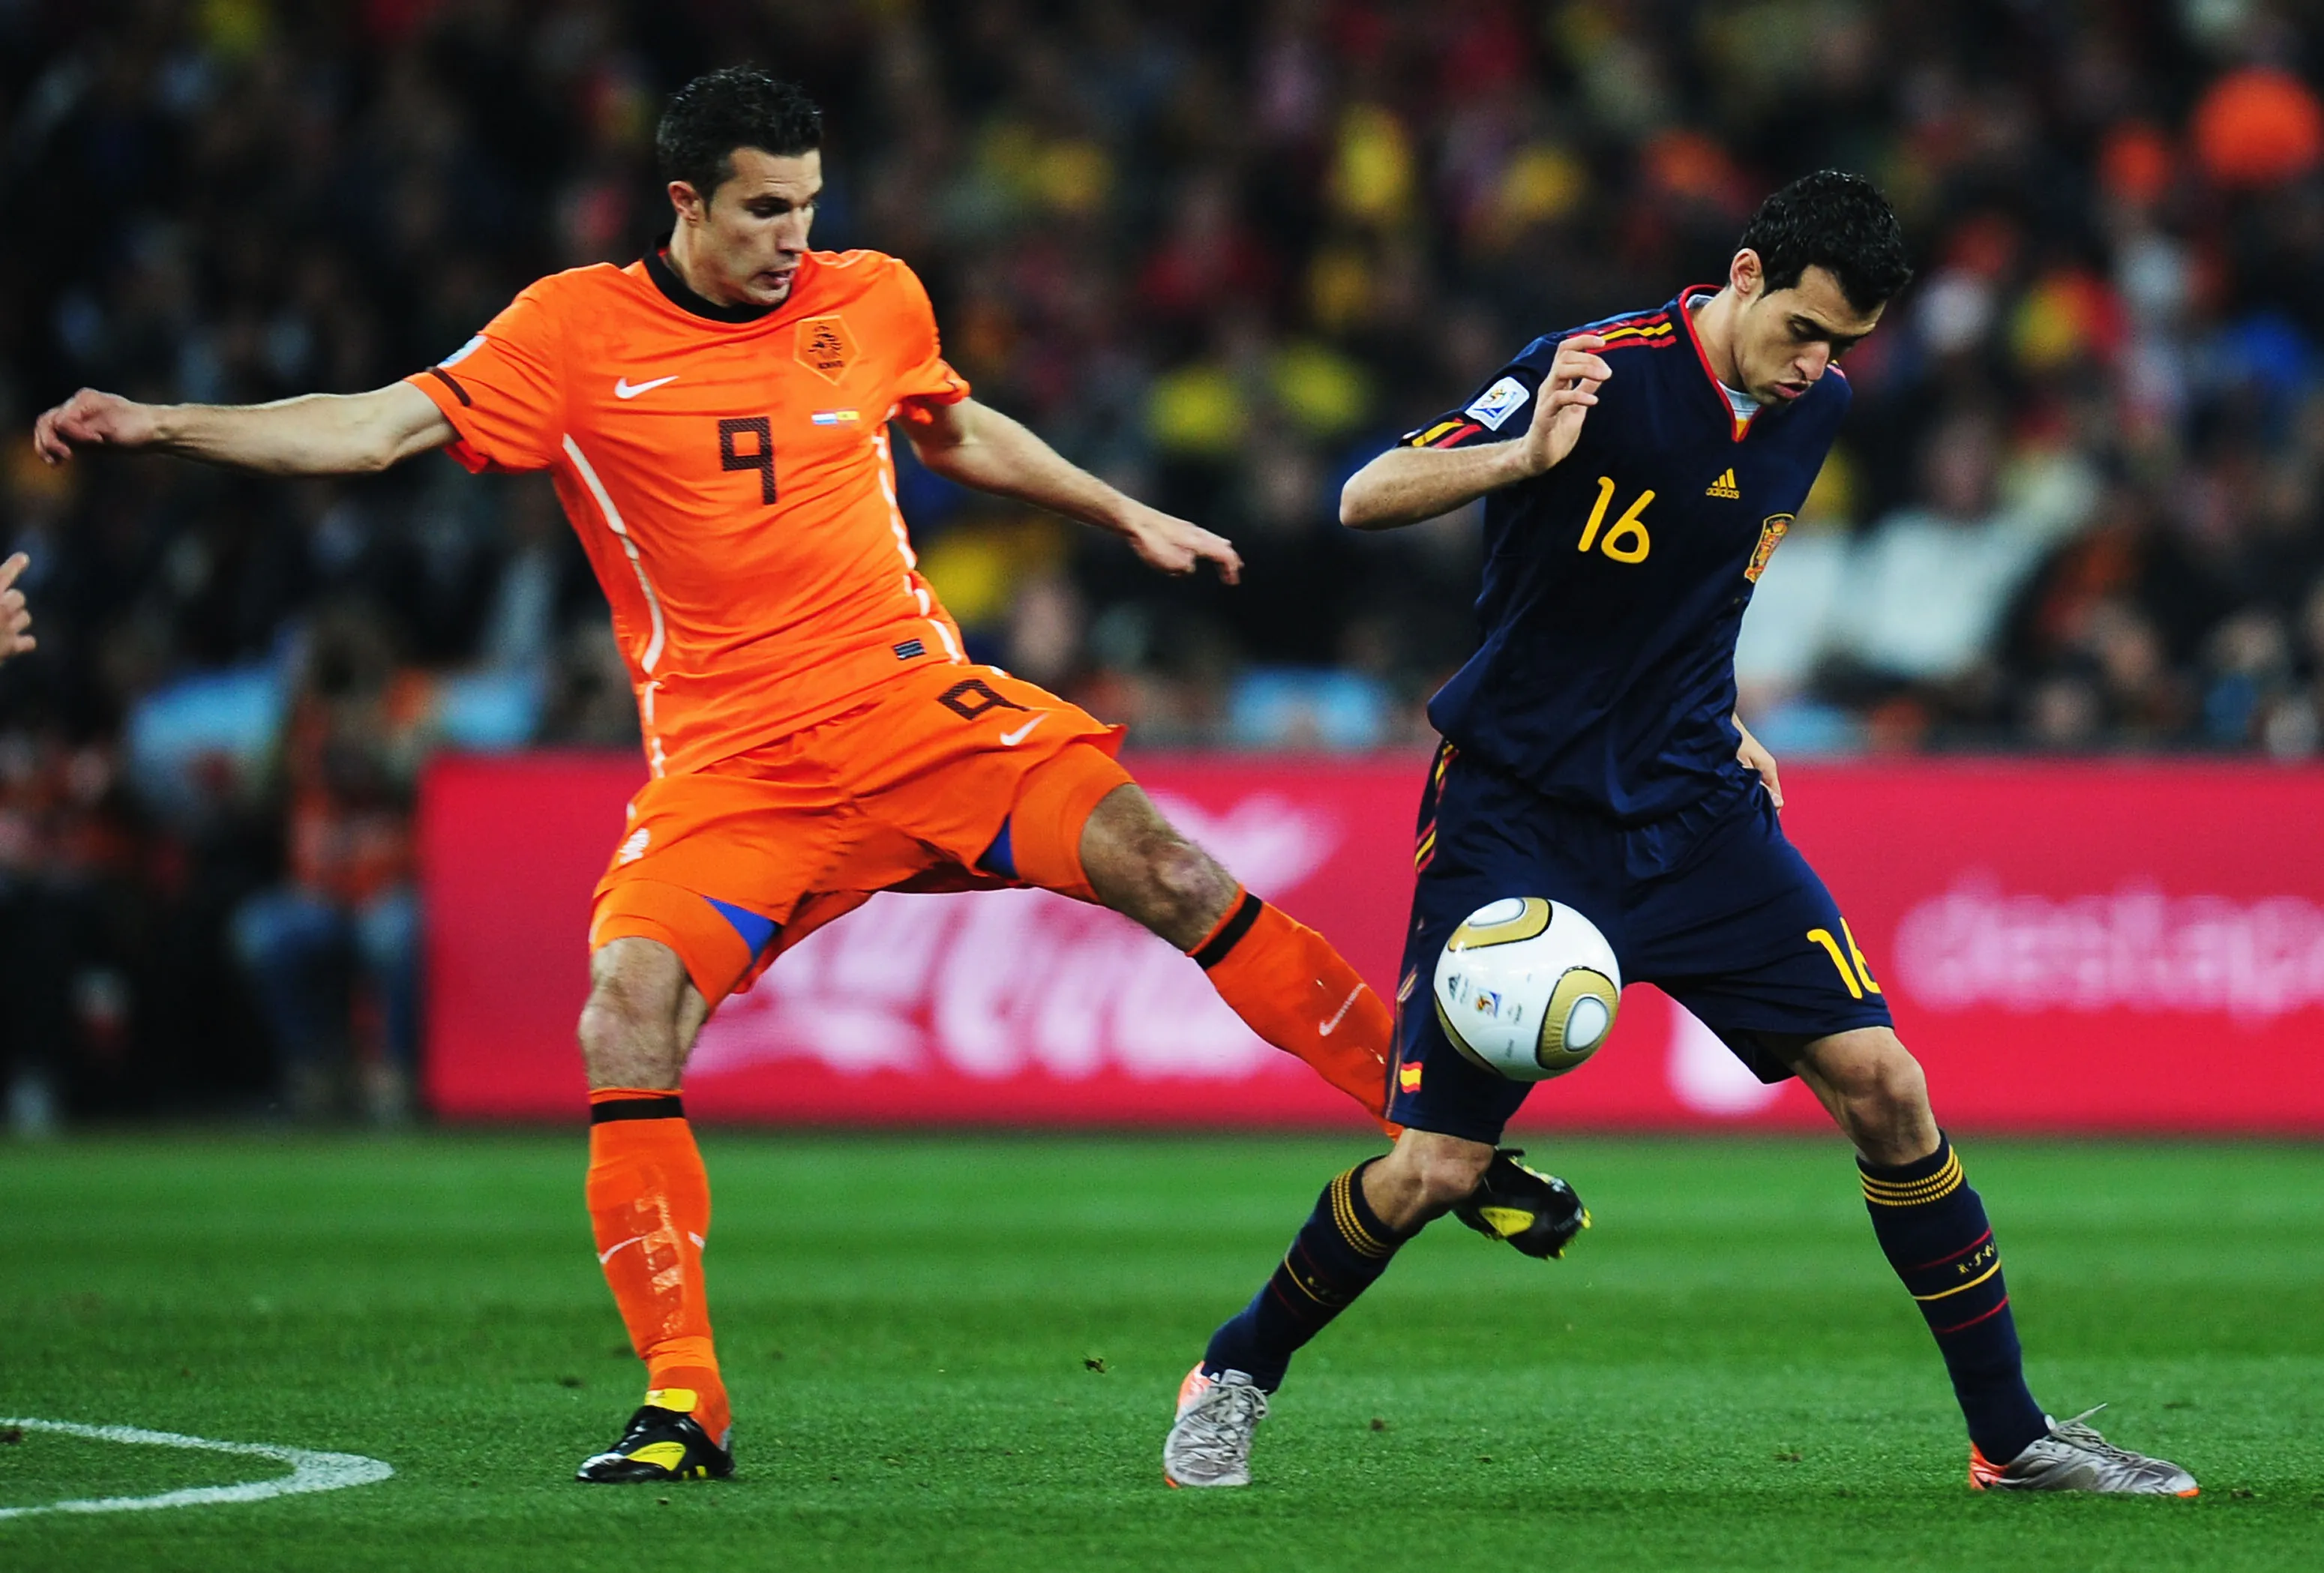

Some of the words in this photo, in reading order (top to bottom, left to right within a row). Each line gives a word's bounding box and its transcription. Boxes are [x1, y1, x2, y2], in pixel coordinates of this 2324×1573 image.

[718, 416, 777, 506] 9
[1705, 487, 1740, 499] adidas
[1578, 476, 1656, 564] 16
[936, 679, 1030, 721] 9
